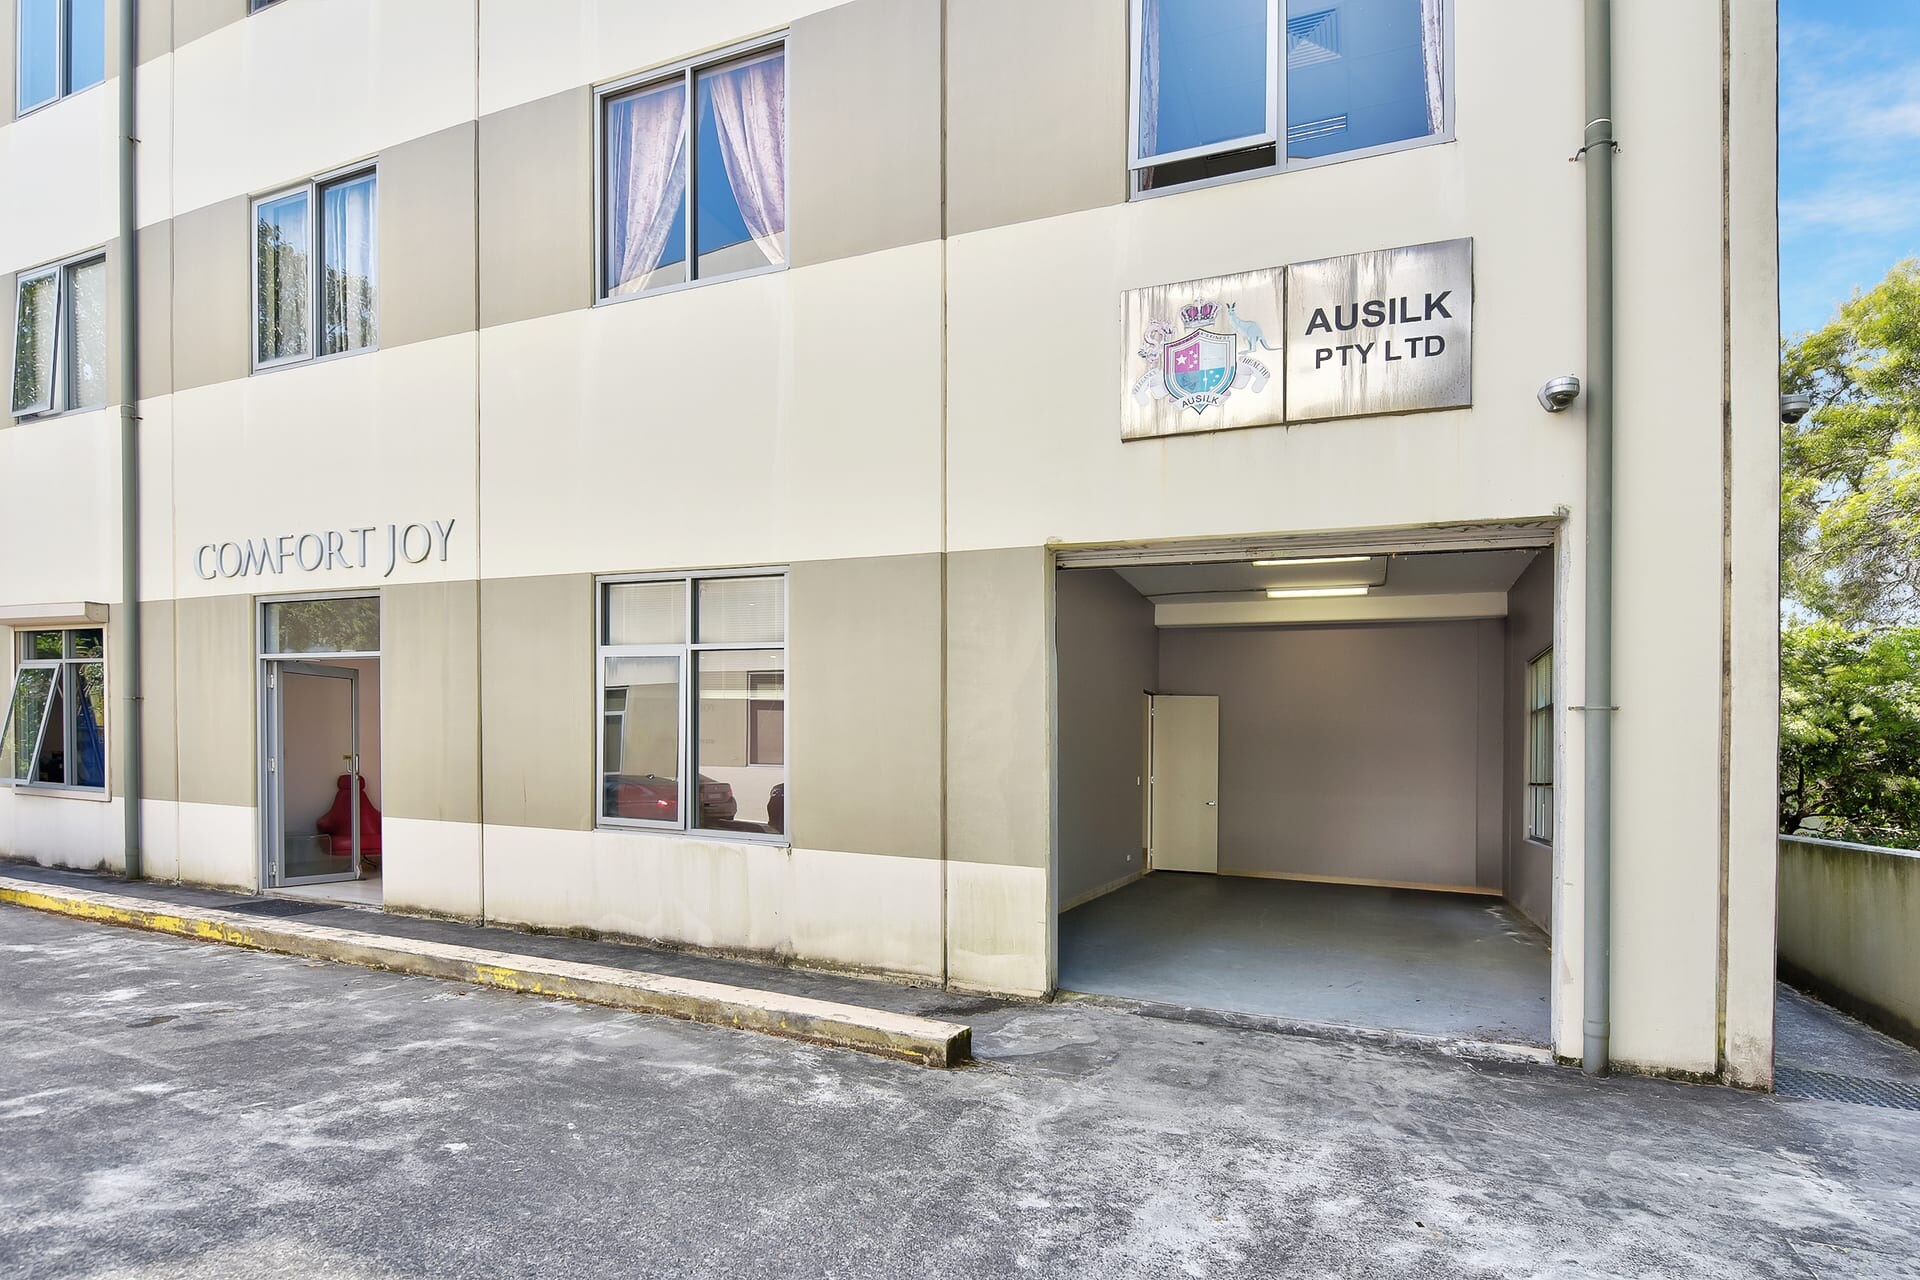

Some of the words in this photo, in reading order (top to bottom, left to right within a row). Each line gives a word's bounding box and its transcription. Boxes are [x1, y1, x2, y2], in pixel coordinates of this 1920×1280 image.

[1305, 290, 1453, 336] AUSILK
[1242, 357, 1269, 377] HEALTH
[1315, 342, 1375, 370] PTY
[1385, 335, 1446, 362] LTD
[1182, 394, 1219, 408] AUSILK
[194, 527, 376, 580] COMFORT
[384, 519, 455, 577] JOY
